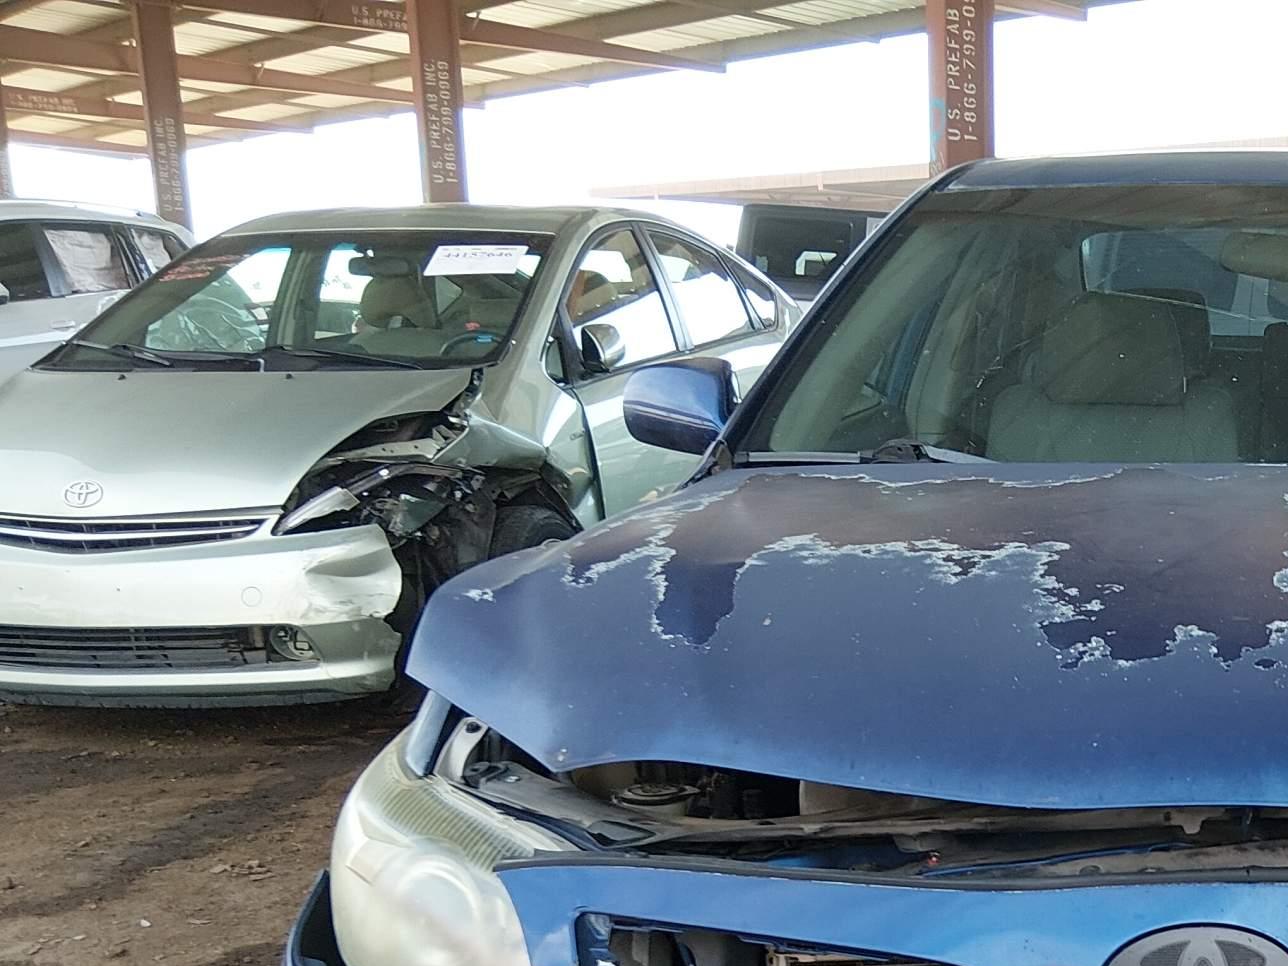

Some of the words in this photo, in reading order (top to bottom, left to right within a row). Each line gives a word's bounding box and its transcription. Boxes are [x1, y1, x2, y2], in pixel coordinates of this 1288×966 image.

[423, 59, 438, 86] INC.
[945, 8, 960, 90] PREFAB
[426, 93, 443, 149] PREFAB
